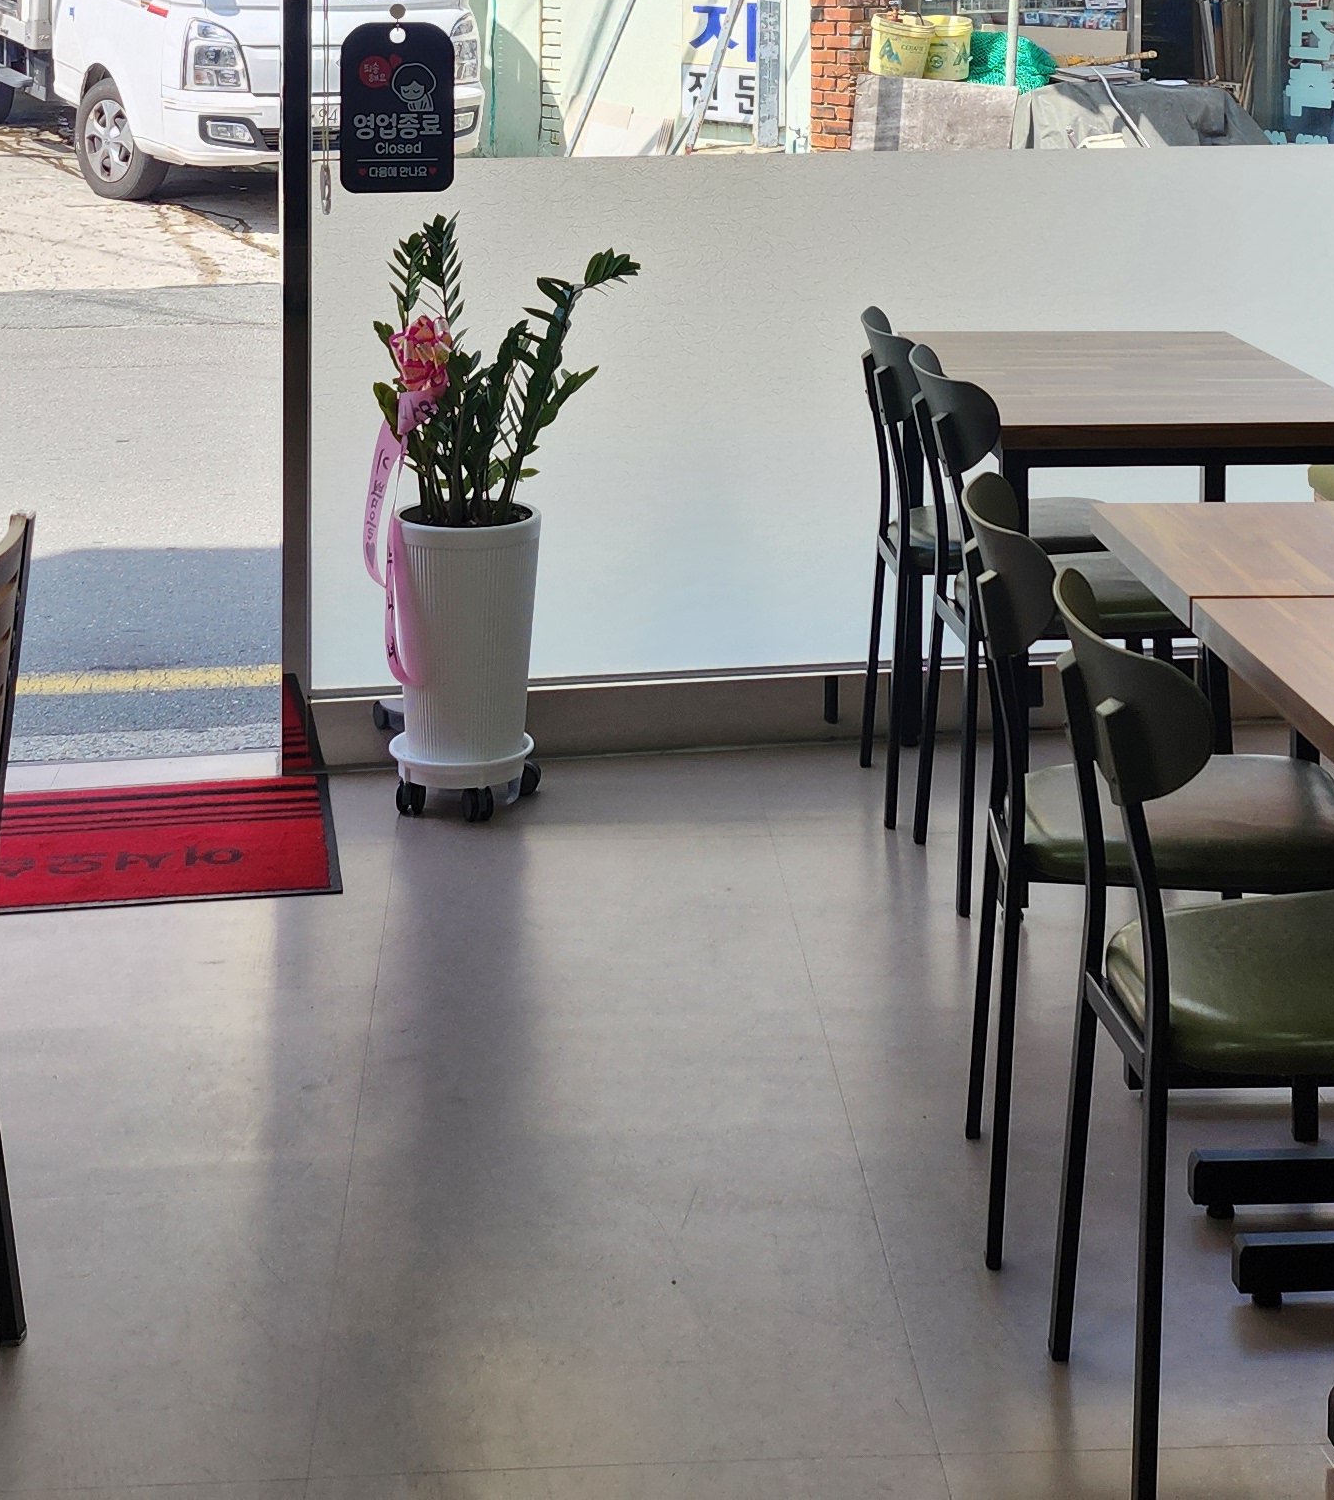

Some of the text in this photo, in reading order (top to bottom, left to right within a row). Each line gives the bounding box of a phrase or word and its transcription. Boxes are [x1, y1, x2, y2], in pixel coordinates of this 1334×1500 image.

[353, 113, 443, 140] 영업종료
[374, 141, 422, 155] Closed
[368, 166, 397, 178] 다음에
